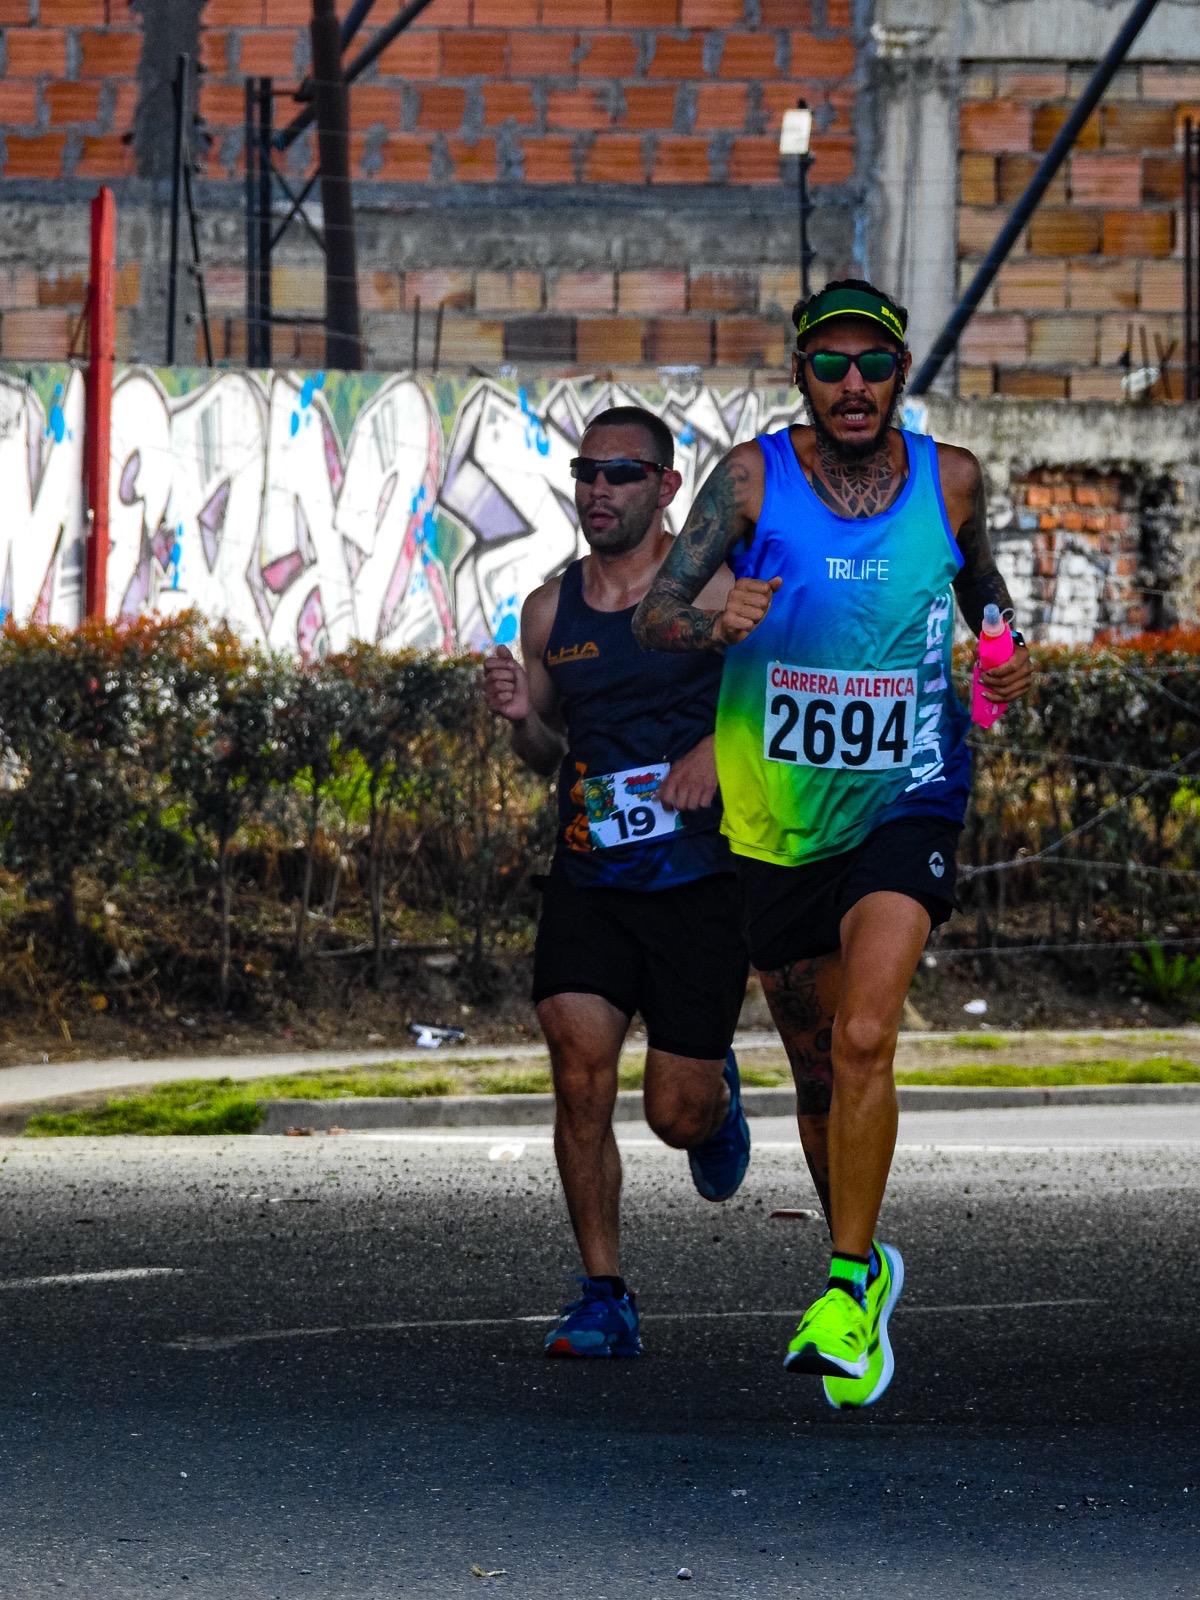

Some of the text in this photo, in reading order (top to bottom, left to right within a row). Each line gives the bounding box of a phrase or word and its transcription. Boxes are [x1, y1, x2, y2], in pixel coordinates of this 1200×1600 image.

[826, 557, 890, 580] TRILIFE
[771, 667, 915, 697] CARRERA ATLETICA
[768, 694, 908, 766] 2694
[610, 806, 656, 840] 19
